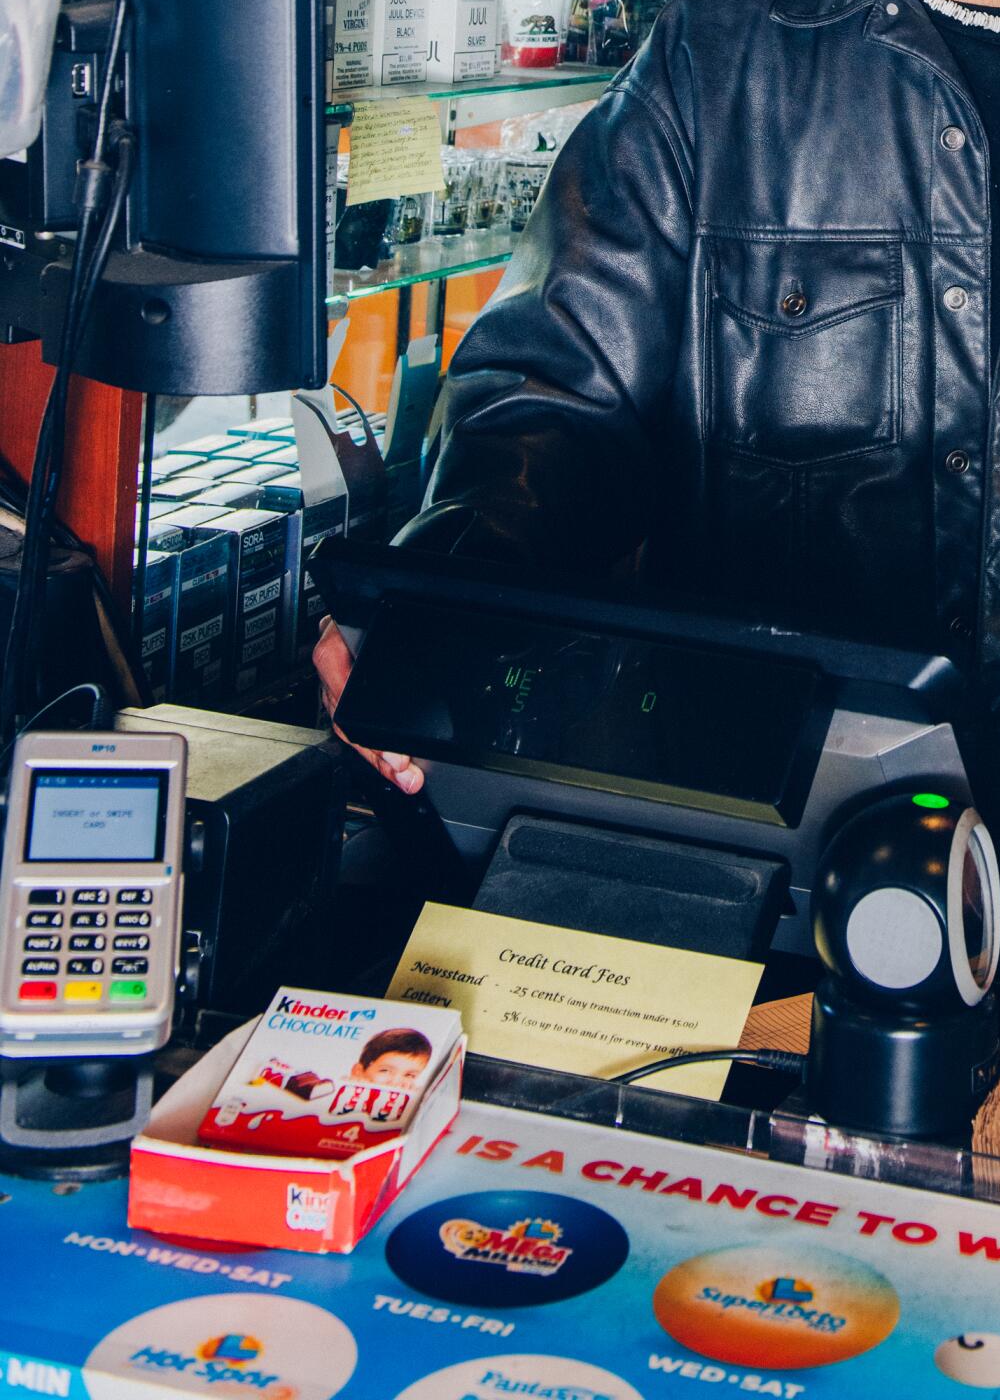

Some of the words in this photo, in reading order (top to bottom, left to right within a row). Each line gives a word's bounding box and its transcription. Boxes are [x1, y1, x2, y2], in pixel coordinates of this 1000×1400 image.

[388, 9, 405, 20] JUUL
[405, 8, 425, 19] DEVICE
[468, 7, 487, 26] JUUL
[396, 27, 415, 38] BLACK
[467, 35, 487, 47] SILVER
[243, 532, 265, 549] SORA
[244, 589, 258, 608] 25K
[258, 581, 280, 601] PUFFS
[181, 631, 198, 650] 25K
[198, 620, 221, 642] PUFFS
[91, 744, 117, 753] RP10
[53, 809, 84, 818] INSERT
[106, 809, 133, 818] SWIPE
[83, 821, 107, 829] CARD
[499, 947, 548, 971] Credit
[550, 958, 592, 980] Card
[592, 966, 632, 987] Fees
[401, 986, 453, 1009] Lottery
[410, 960, 488, 988] Newsstand
[508, 985, 526, 998] .25
[530, 987, 566, 1005] cents
[566, 996, 588, 1011] (any
[589, 1000, 641, 1020] transaction
[642, 1009, 670, 1025] under
[671, 1016, 699, 1031] $5.00)
[267, 1014, 367, 1041] CHOCOLATE
[457, 1134, 516, 1163] IS
[521, 1148, 570, 1174] A
[580, 1157, 834, 1227] CHANCE
[843, 1208, 938, 1246] TO
[480, 1230, 569, 1262] MEGA
[695, 1286, 847, 1333] SuperLotto
[6, 1358, 71, 1398] MIN
[130, 1345, 191, 1372] Hot
[196, 1358, 285, 1391] Spot
